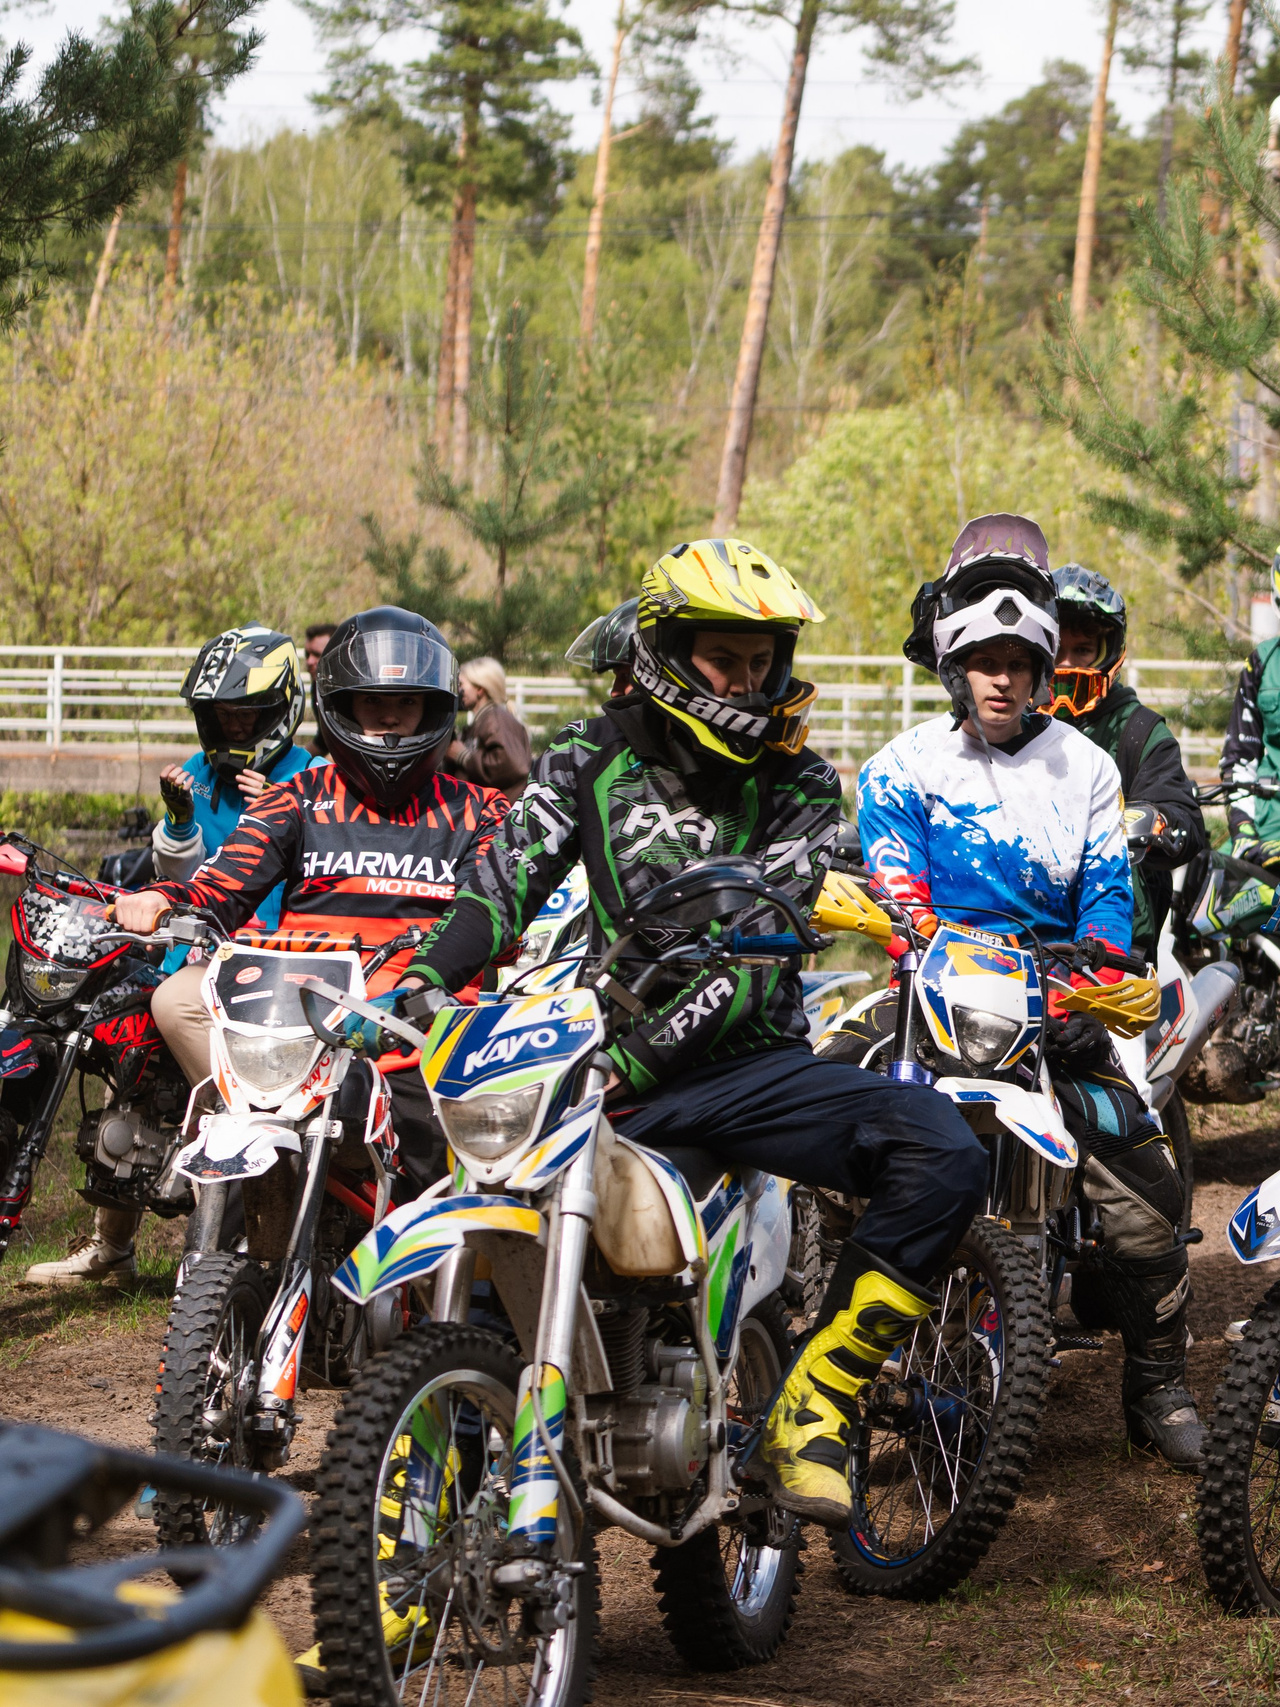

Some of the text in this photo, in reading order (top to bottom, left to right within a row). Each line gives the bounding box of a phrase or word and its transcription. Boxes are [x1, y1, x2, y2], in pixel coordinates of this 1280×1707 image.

[639, 854, 679, 864] TEAM
[366, 878, 456, 899] MOTORS
[415, 908, 457, 957] TEAM
[669, 977, 734, 1041] FXR
[94, 1011, 153, 1045] KAY
[567, 1020, 594, 1033] MX
[462, 1027, 558, 1077] KAYO
